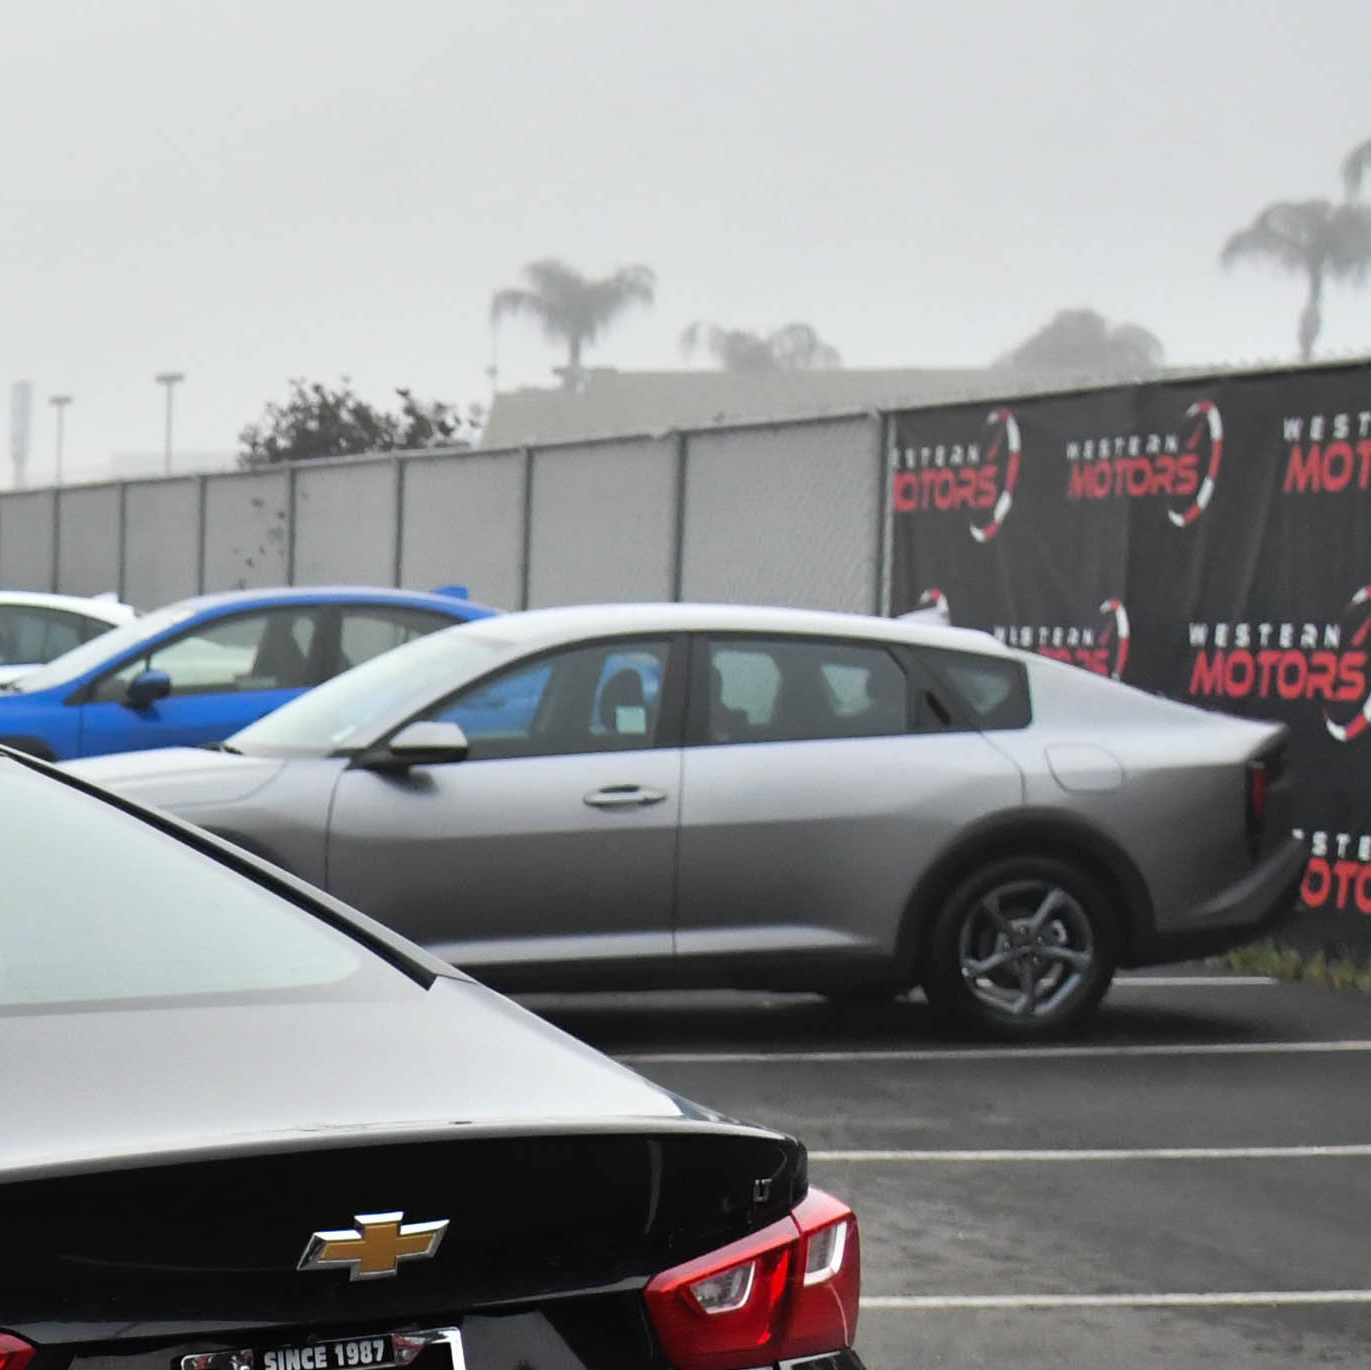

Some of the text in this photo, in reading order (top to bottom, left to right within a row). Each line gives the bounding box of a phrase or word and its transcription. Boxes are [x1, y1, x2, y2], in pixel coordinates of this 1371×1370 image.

[1066, 433, 1178, 460] WESTERN
[1068, 453, 1199, 499] MOTORS
[1188, 622, 1340, 648] WESTERN
[1189, 650, 1367, 700] MOTORS
[333, 1339, 385, 1367] 1987
